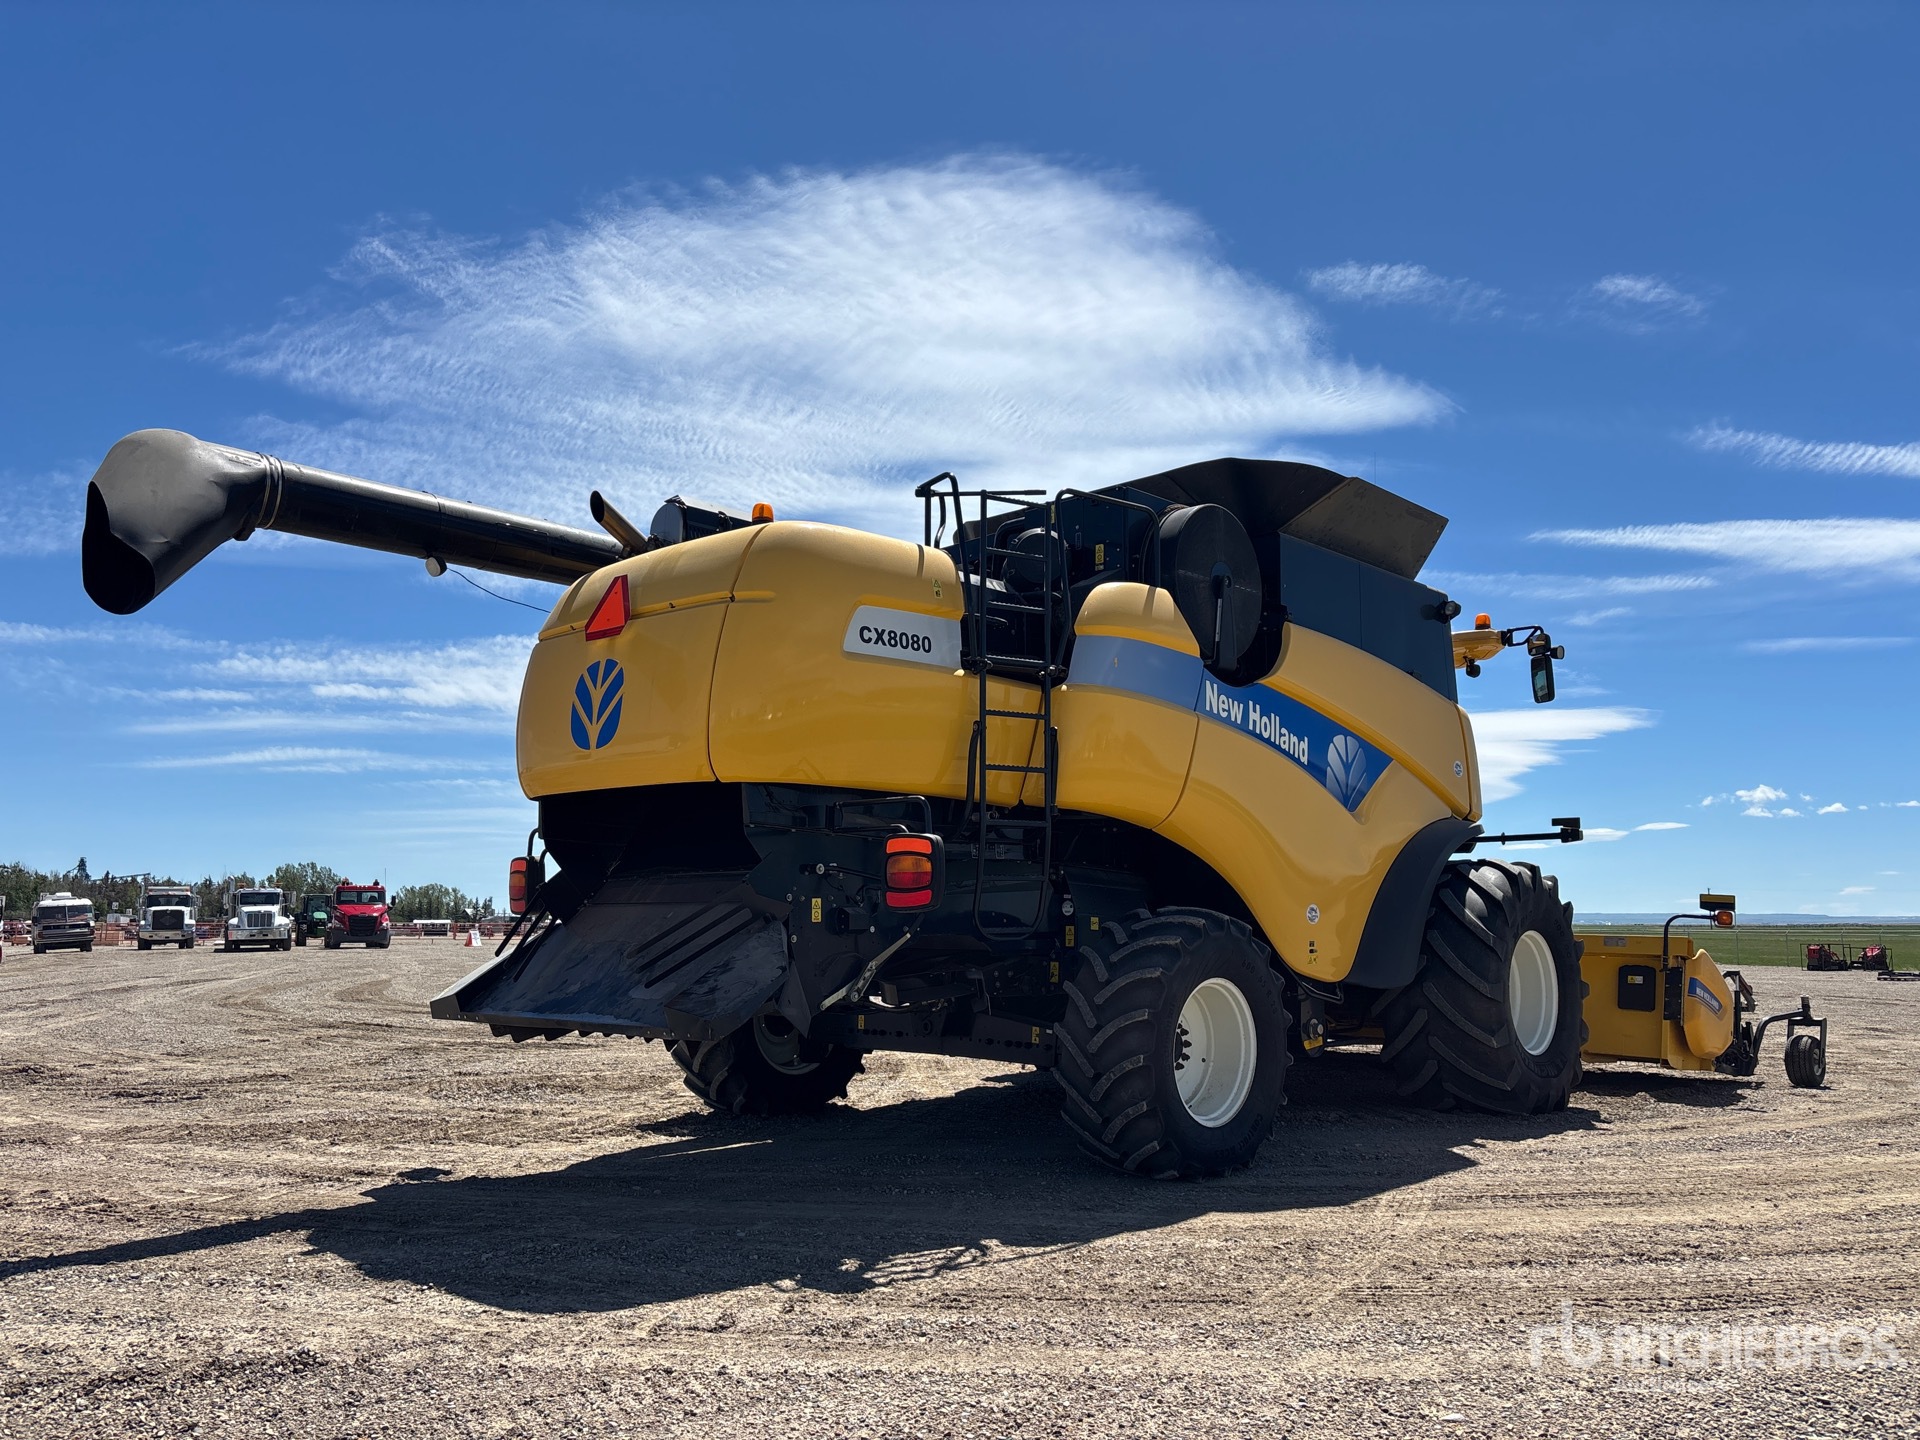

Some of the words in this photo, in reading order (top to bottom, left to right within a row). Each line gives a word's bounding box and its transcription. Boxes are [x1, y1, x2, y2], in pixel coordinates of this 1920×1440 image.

[858, 625, 932, 654] CX8080
[1204, 679, 1244, 725] New
[1248, 700, 1309, 765] Holland
